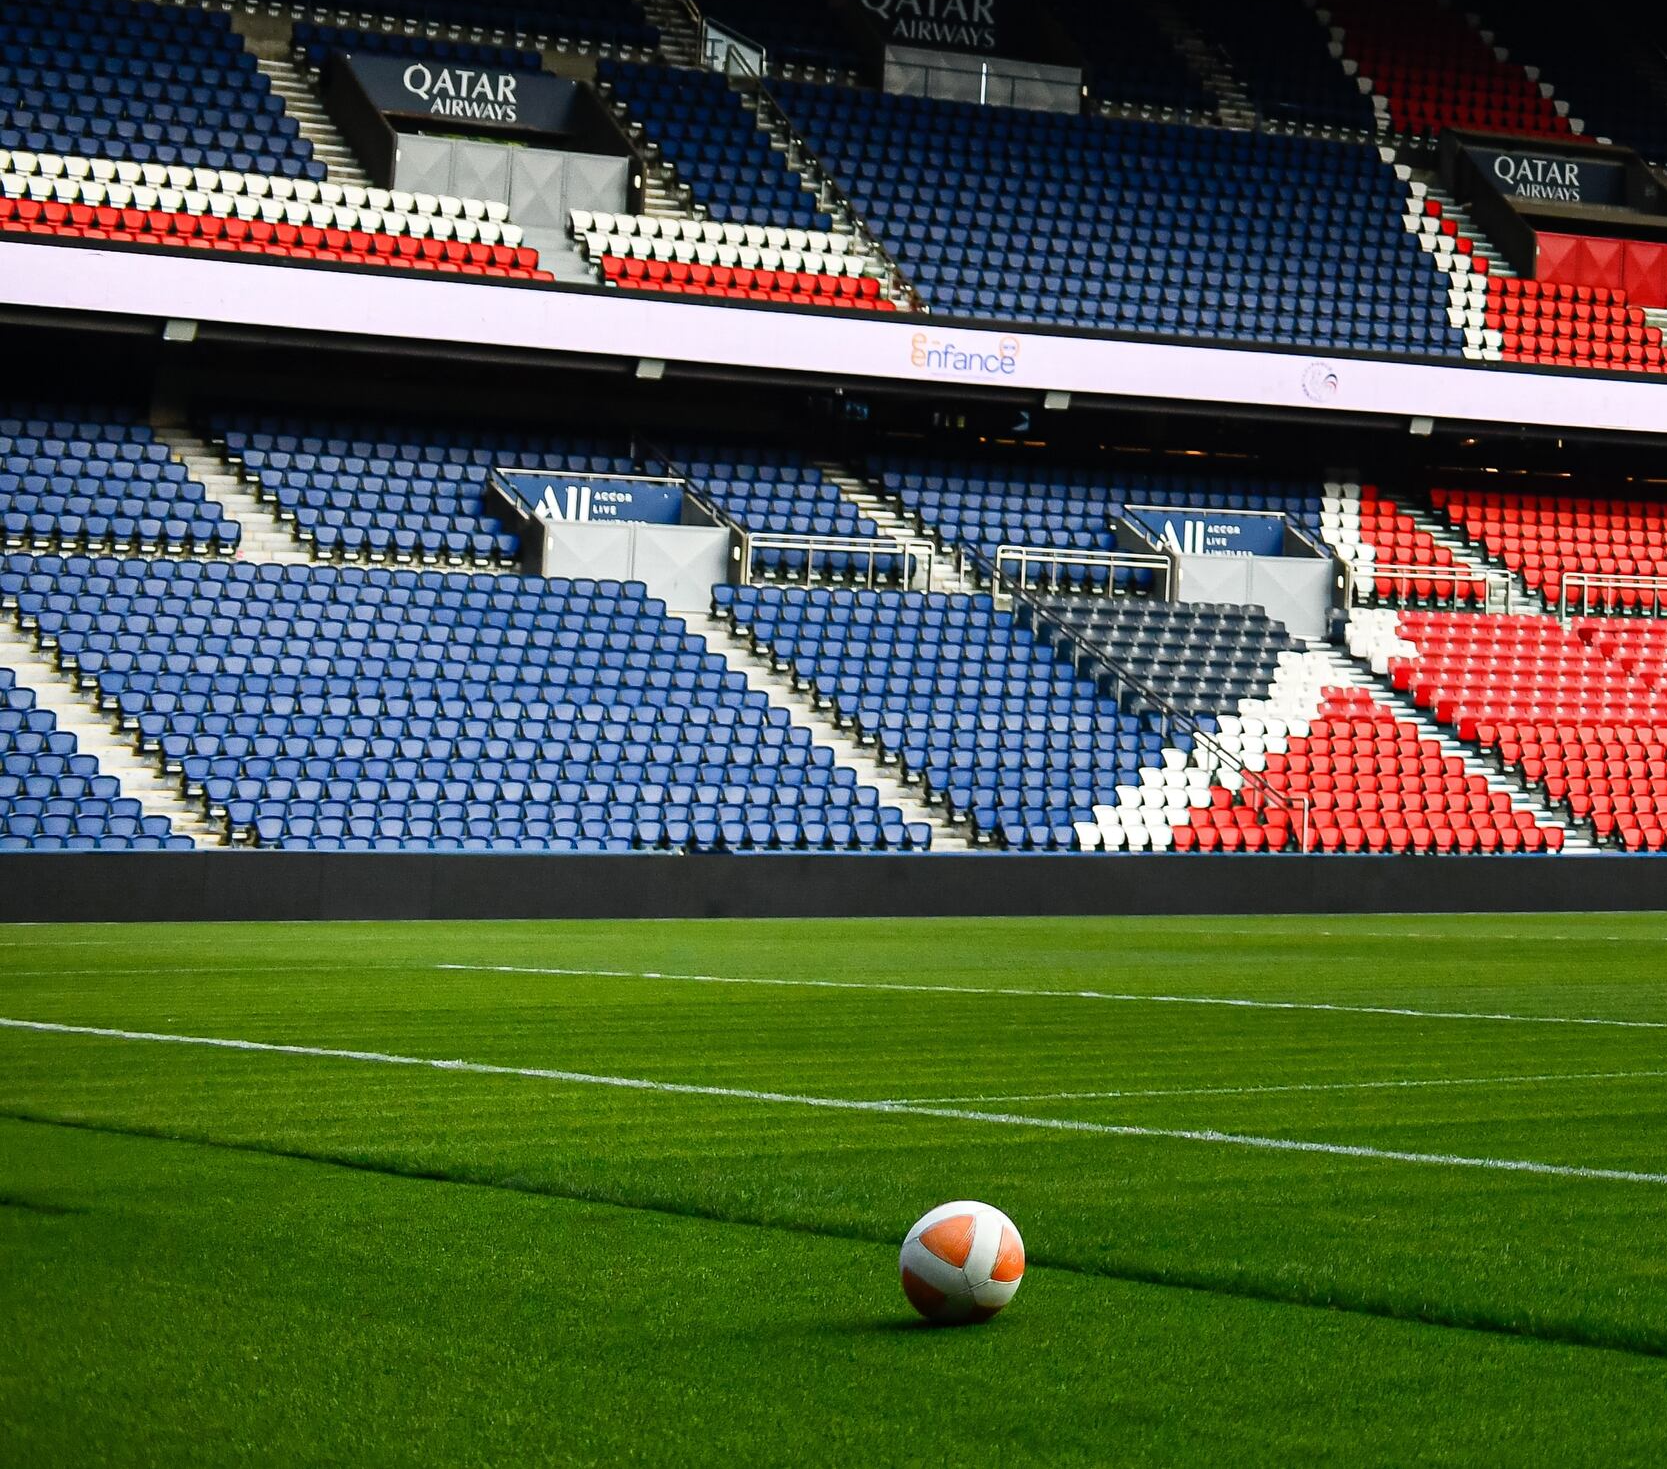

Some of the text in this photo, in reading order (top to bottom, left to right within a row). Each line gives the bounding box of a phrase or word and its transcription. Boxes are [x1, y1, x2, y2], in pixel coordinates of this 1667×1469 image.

[893, 17, 995, 48] AIRWAYS
[403, 63, 517, 103] QATAR
[430, 97, 517, 122] AIRWAYS
[1494, 156, 1580, 186] QATAR
[1515, 183, 1580, 202] AIRWAYS
[594, 491, 632, 503] ACCOR
[593, 505, 617, 516] LIVE
[1207, 525, 1240, 534] ACCOR
[1206, 537, 1227, 547] LIVE
